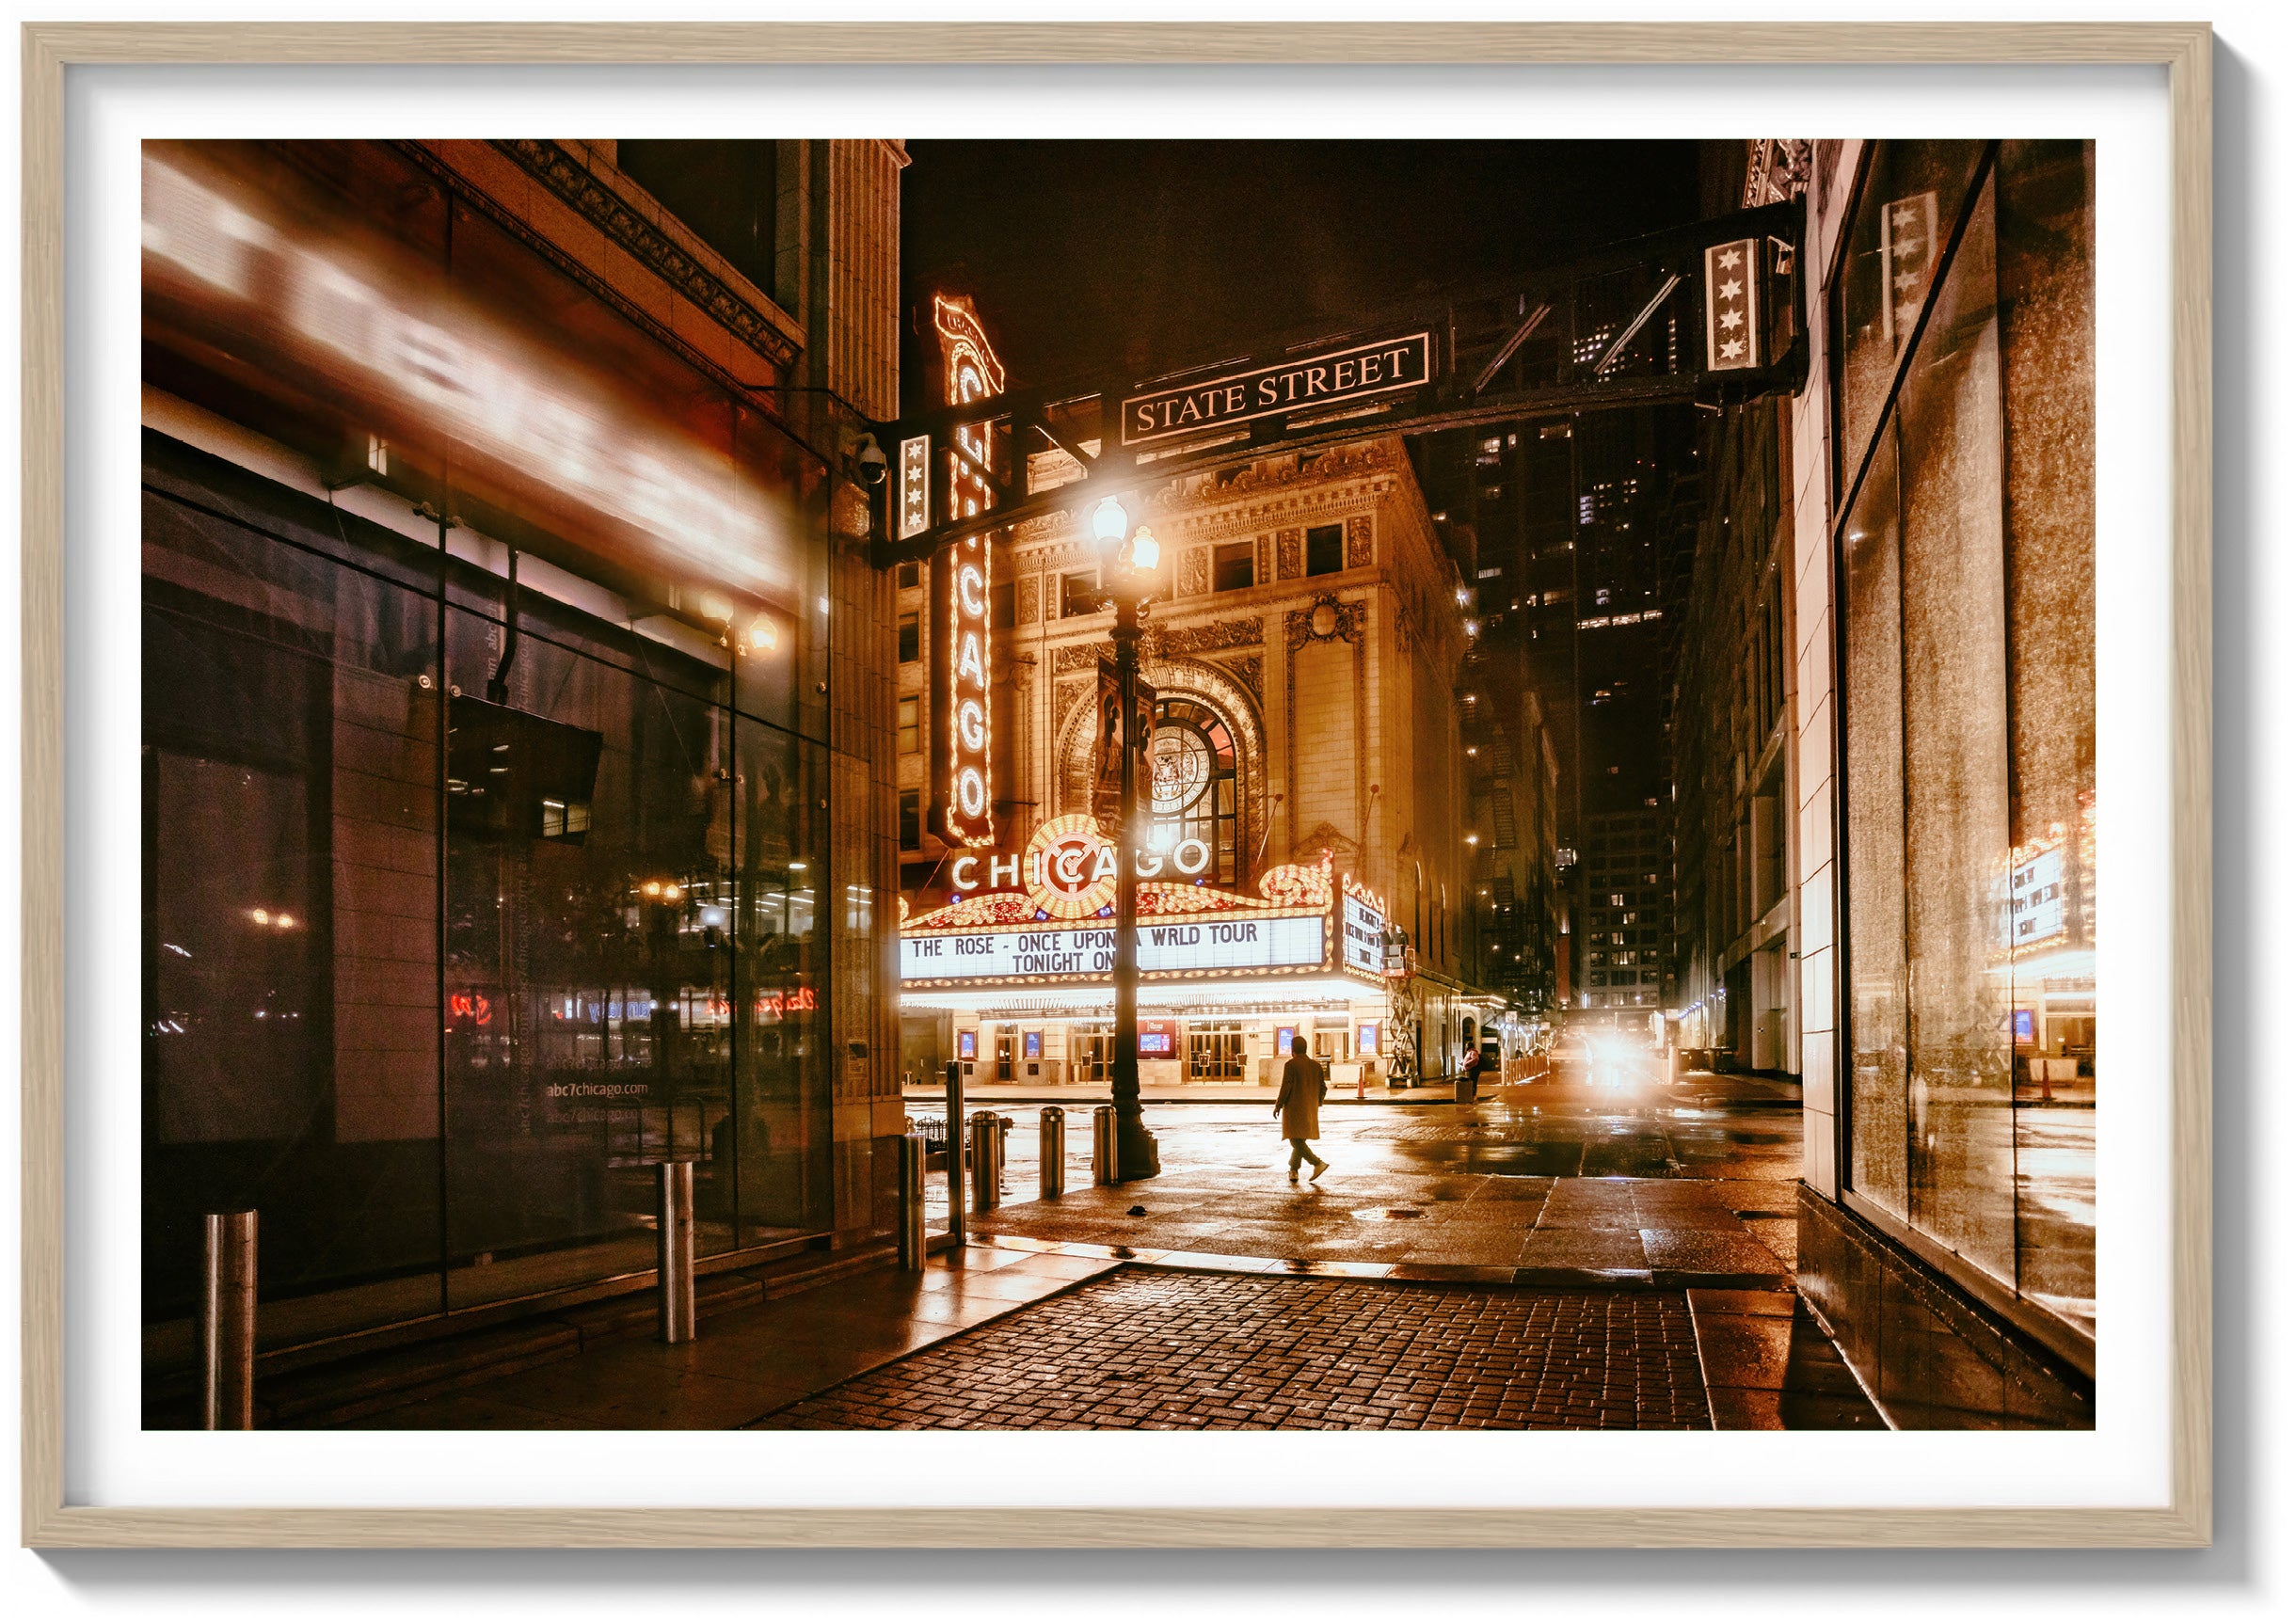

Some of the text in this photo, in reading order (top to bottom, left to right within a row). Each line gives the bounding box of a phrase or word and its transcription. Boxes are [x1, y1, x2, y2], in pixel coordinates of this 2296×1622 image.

[1137, 347, 1410, 432] STATE STREET
[951, 838, 1210, 889] CHICAGO
[913, 939, 943, 958] THE
[955, 937, 995, 955] ROSE
[1018, 933, 1061, 952] ONCE
[1073, 930, 1117, 949] UPON
[1151, 927, 1200, 946] WRLD
[1208, 923, 1258, 945] TOUR
[1012, 952, 1083, 973] TONIGHT
[547, 1082, 648, 1100] abc7chicago.com
